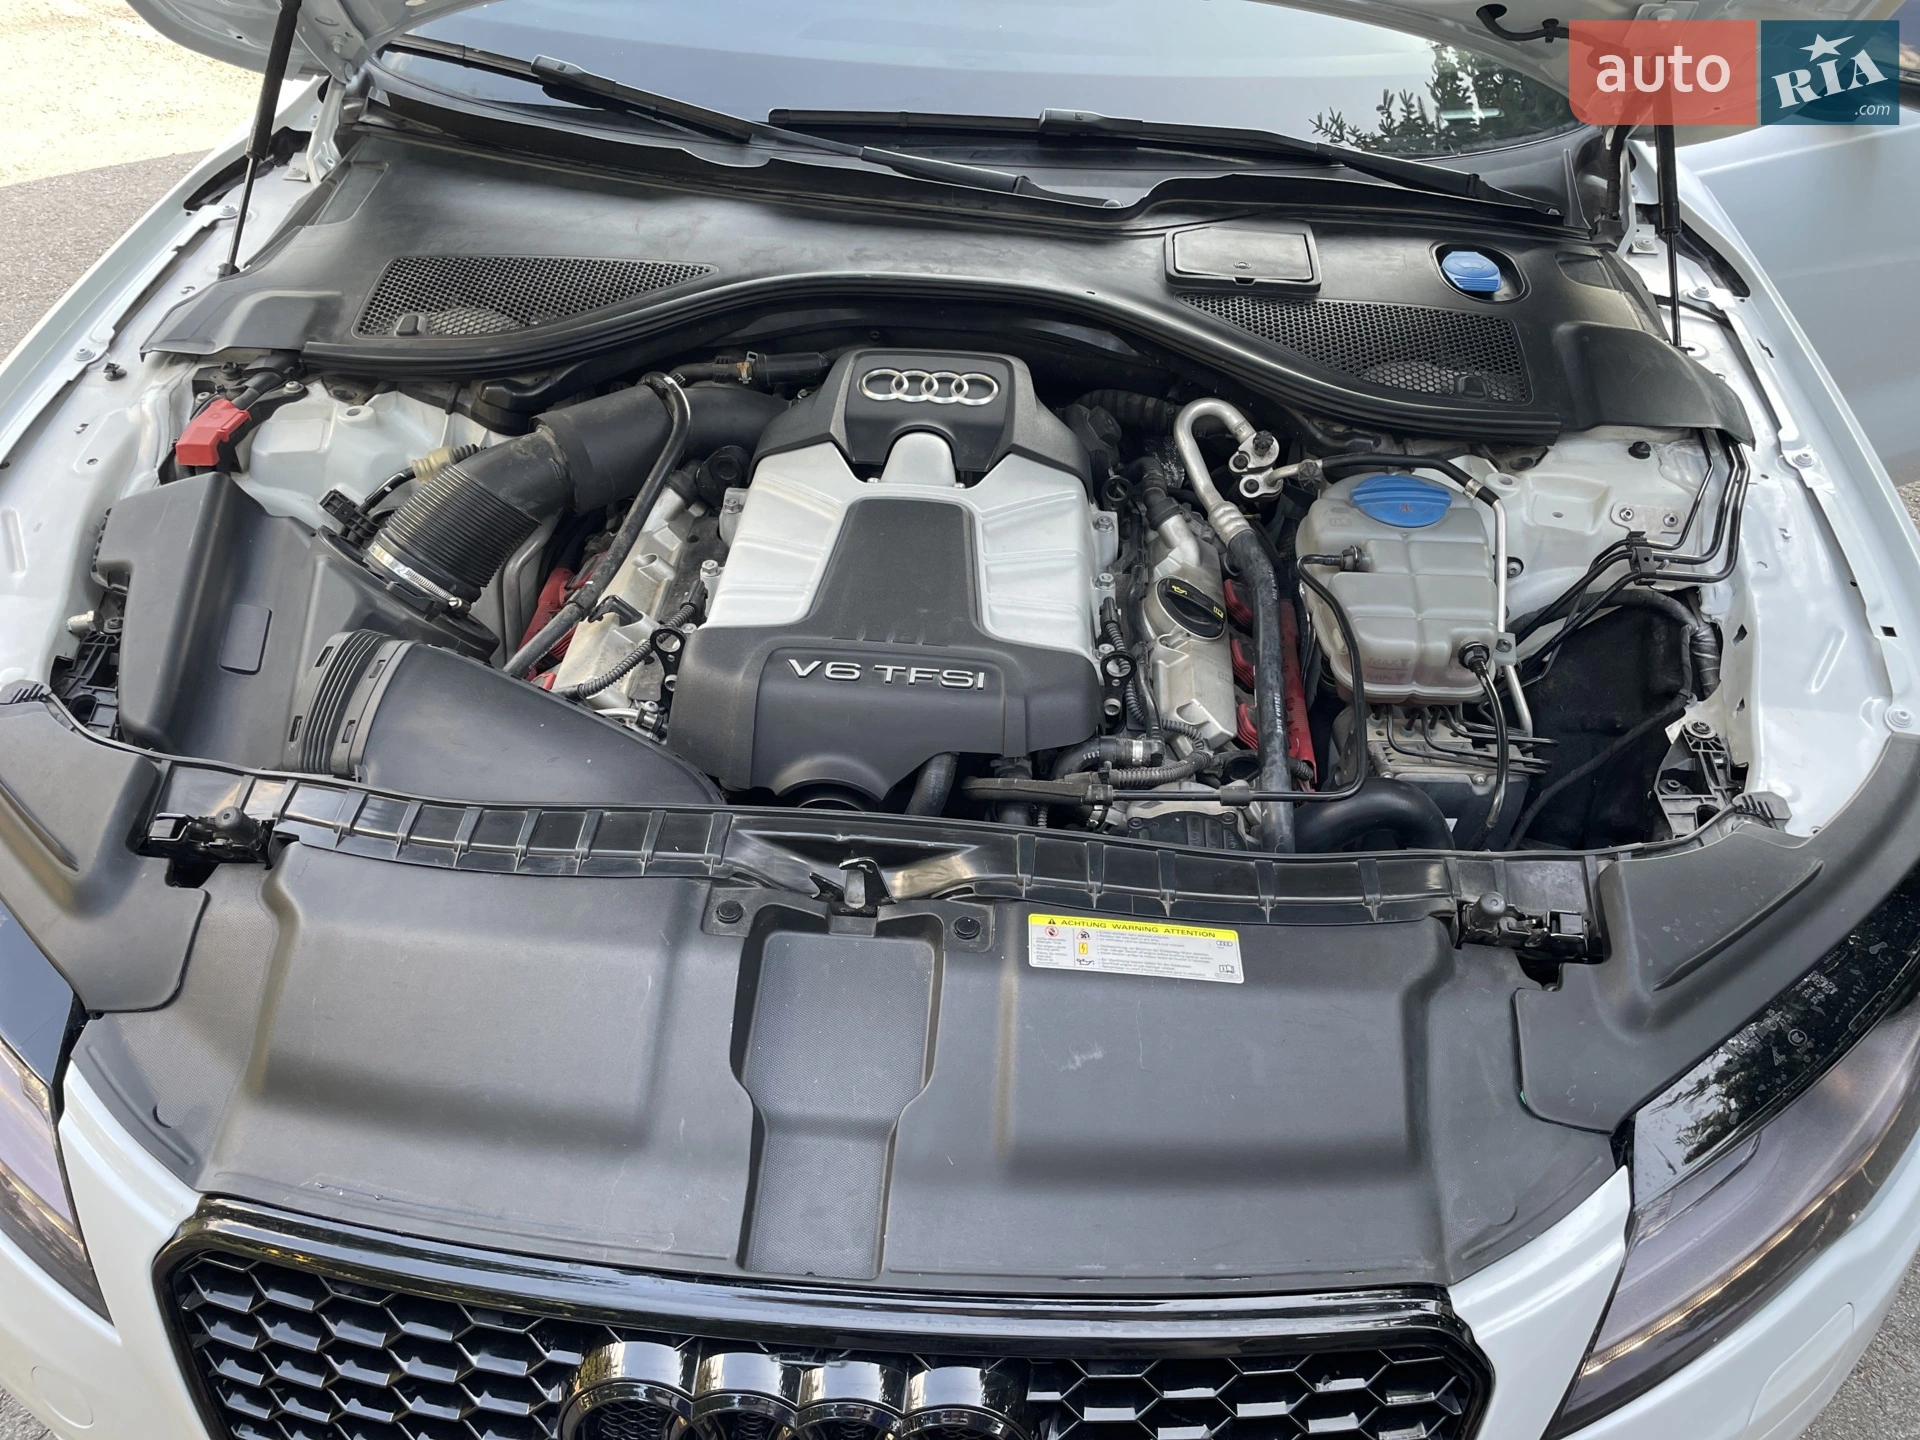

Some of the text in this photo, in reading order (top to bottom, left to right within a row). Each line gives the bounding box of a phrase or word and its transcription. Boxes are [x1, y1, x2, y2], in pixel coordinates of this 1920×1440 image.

[1368, 657, 1399, 667] MAX
[788, 658, 985, 691] V6 TFSI
[1061, 919, 1216, 938] ACHTUNG WARNING ATTENTION
